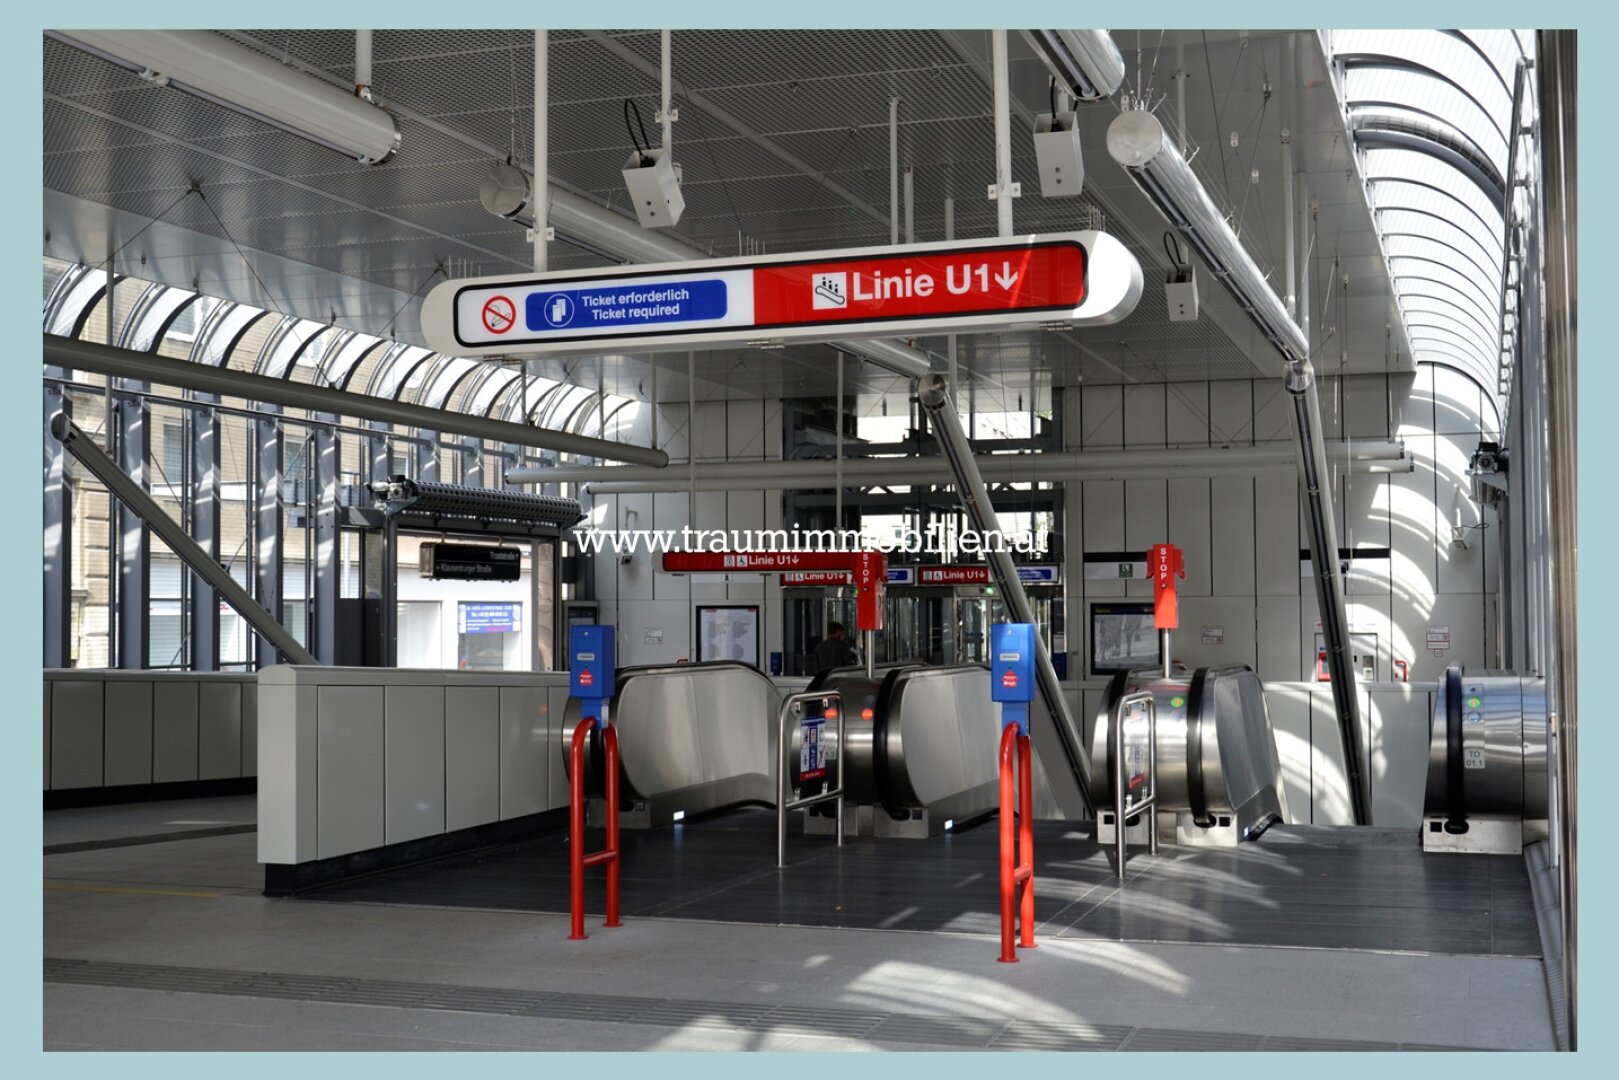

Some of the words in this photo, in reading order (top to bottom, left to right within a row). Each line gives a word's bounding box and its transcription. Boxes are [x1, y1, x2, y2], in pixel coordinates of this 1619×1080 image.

[853, 268, 934, 301] Linie
[946, 263, 989, 295] U1
[582, 295, 616, 307] Ticket
[618, 289, 689, 304] erforderlich
[592, 309, 626, 320] Ticket
[628, 303, 680, 319] required
[749, 555, 775, 566] Linie
[777, 554, 791, 565] U1
[862, 553, 870, 584] STOP
[804, 573, 825, 581] Linie
[943, 570, 965, 579] Linie
[967, 570, 979, 579] U1
